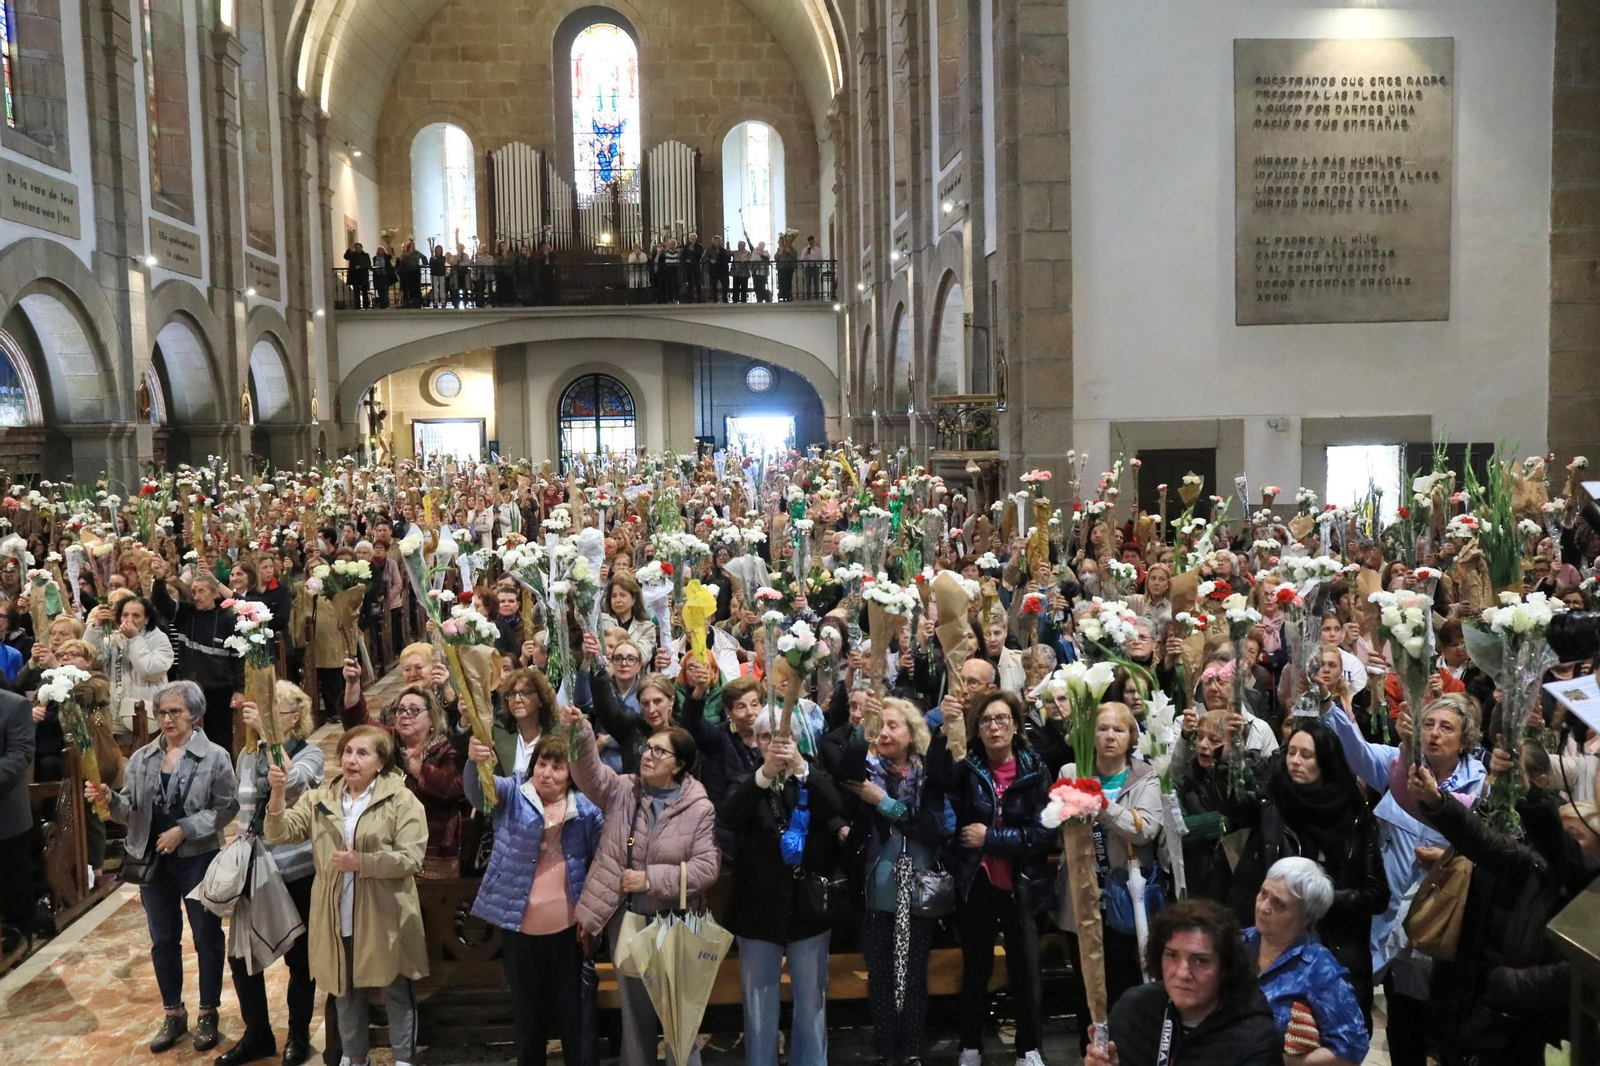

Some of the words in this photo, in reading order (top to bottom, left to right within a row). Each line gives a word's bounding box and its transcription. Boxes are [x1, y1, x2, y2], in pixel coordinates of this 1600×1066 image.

[7, 172, 17, 185] De
[20, 177, 27, 190] la
[49, 188, 57, 200] de
[1159, 1019, 1173, 1061] BIMBA
